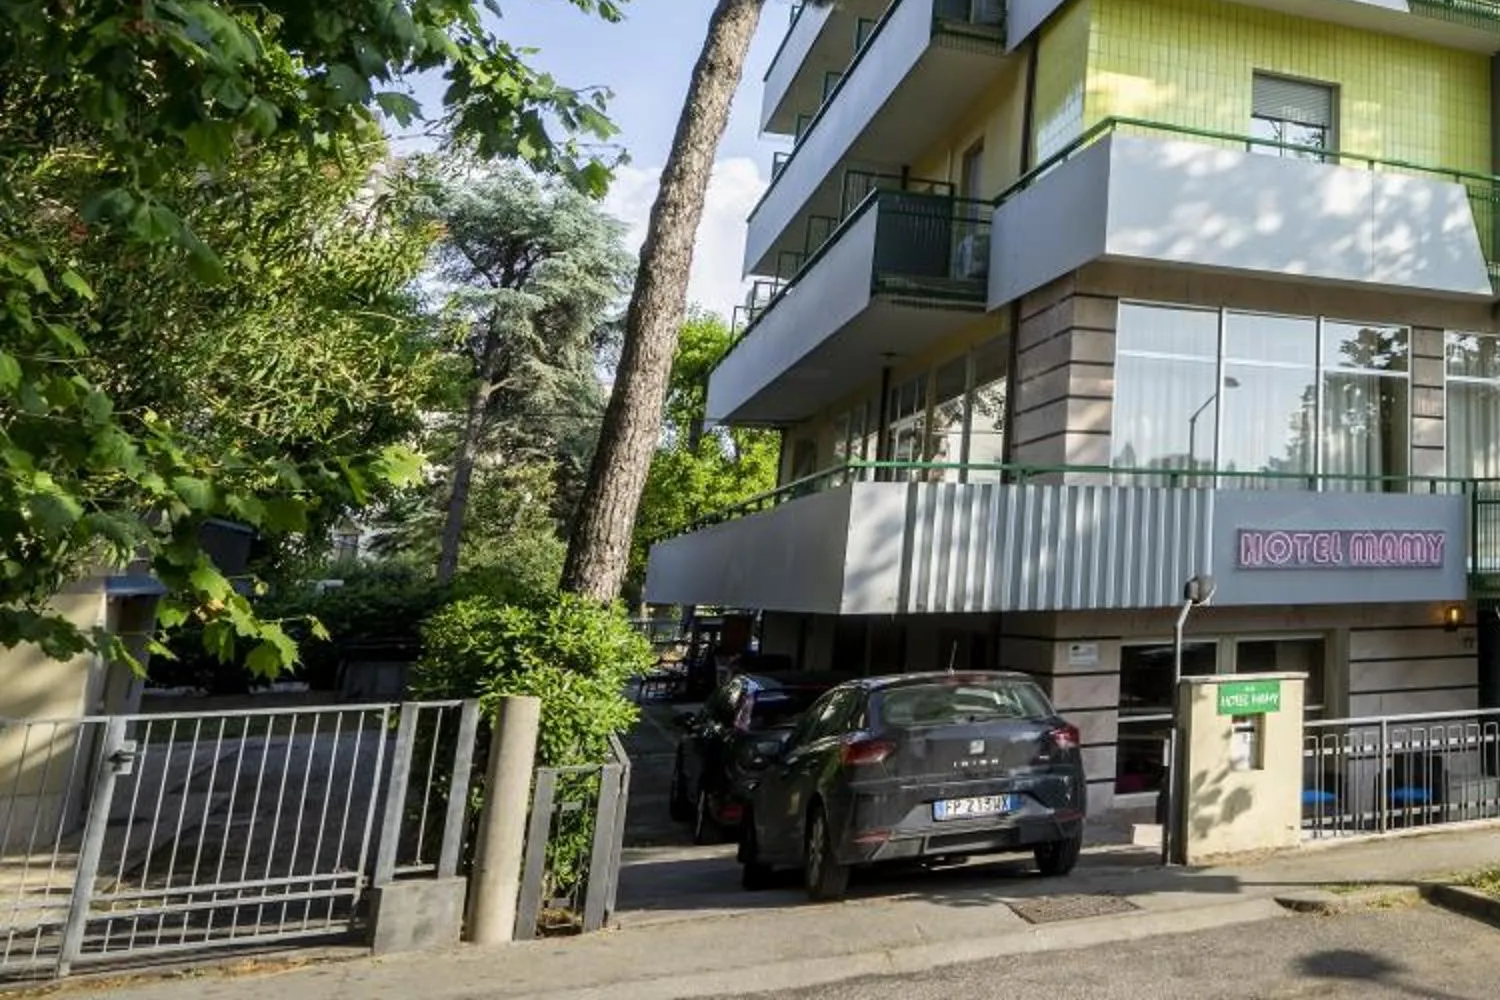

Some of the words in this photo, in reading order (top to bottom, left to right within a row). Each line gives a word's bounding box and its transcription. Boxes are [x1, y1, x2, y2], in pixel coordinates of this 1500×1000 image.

[1241, 531, 1343, 565] HOTEL
[1350, 532, 1445, 565] MAMY
[1221, 693, 1249, 707] HOTEL
